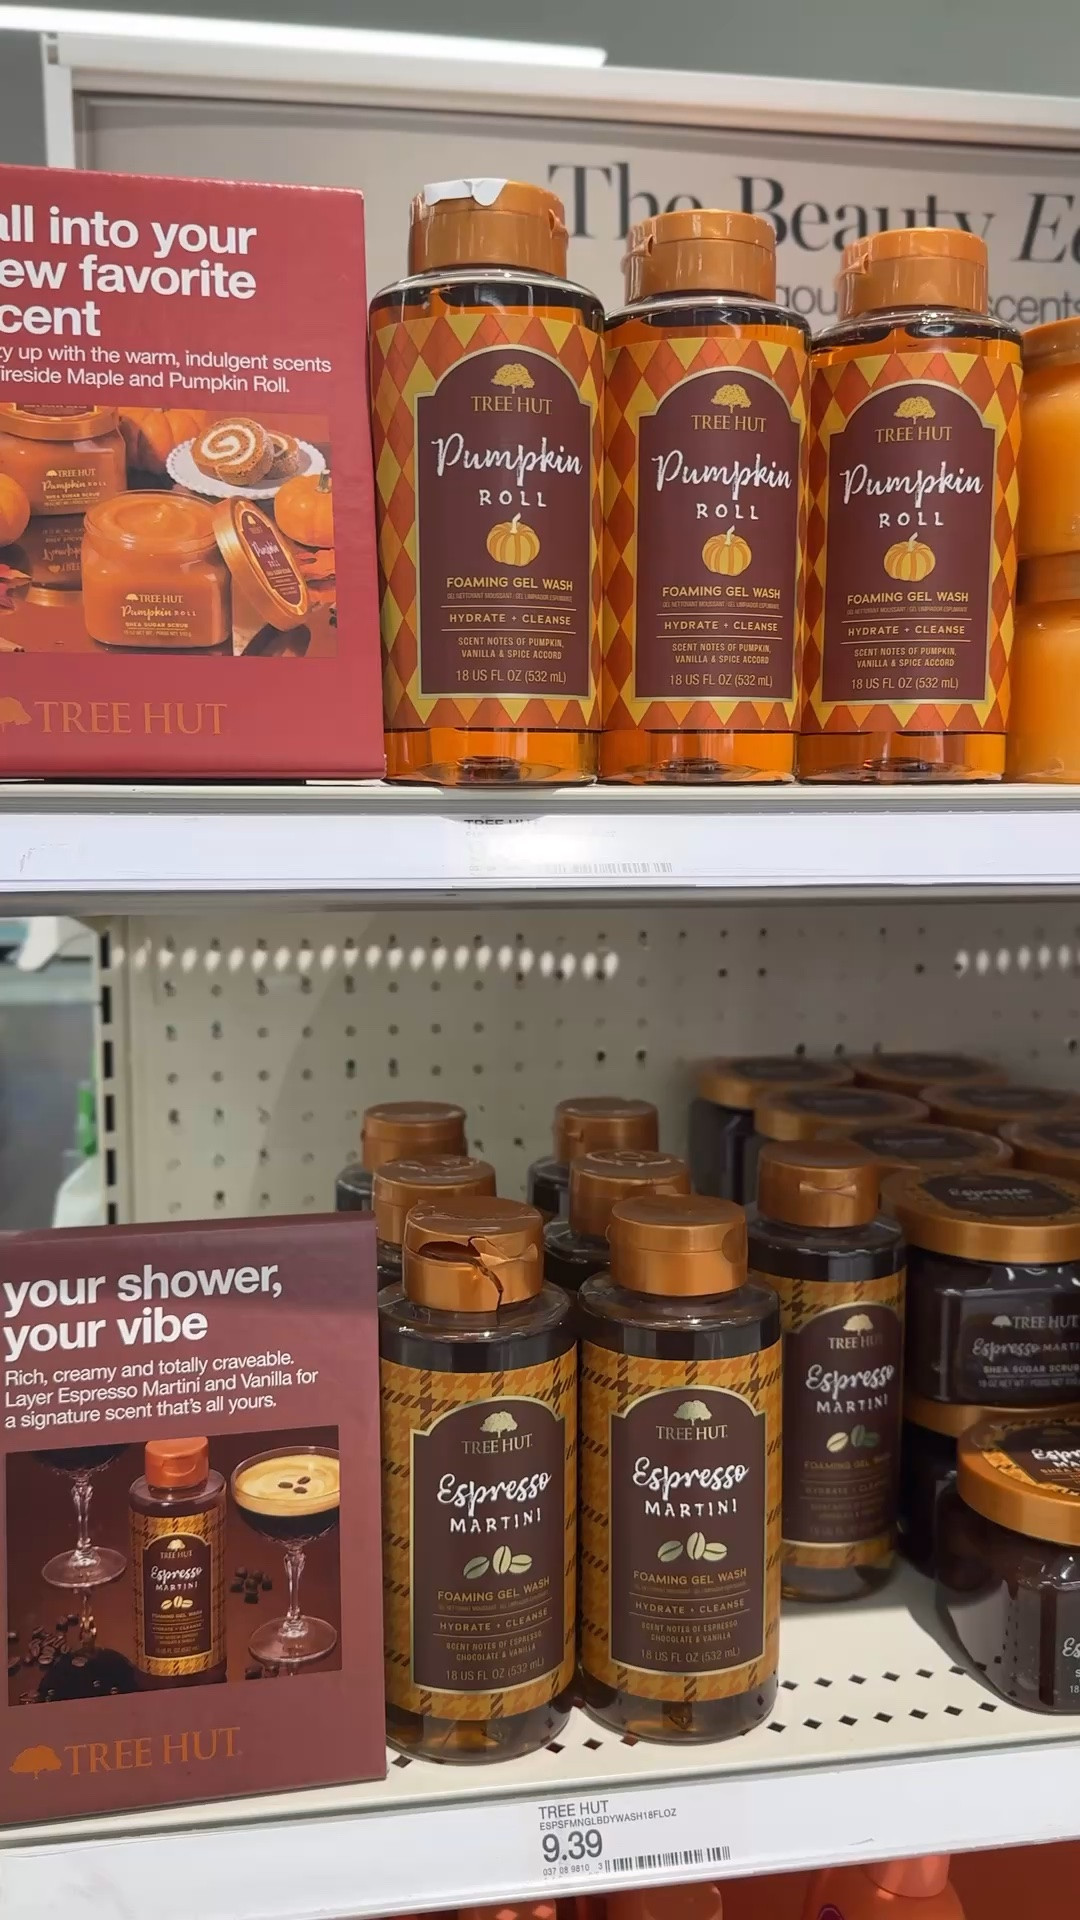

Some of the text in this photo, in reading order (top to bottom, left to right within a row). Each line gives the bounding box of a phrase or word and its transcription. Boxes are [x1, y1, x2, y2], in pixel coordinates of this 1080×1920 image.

[50, 205, 138, 248] into
[151, 221, 257, 259] your
[79, 254, 257, 299] favorite
[18, 344, 332, 374] up with the warm, indulgent scents
[67, 368, 124, 389] Maple
[129, 370, 164, 387] and
[169, 372, 248, 393] Pumpkin
[253, 376, 290, 393] Roll.
[471, 396, 553, 415] TREE HUT
[691, 414, 767, 433] TREE HUT
[875, 426, 952, 443] TREE HUT
[432, 432, 583, 487] Pumpkin
[651, 450, 792, 500] Pumpkin
[839, 461, 984, 508] Pumpkin
[479, 489, 547, 508] ROLL
[696, 503, 759, 520] ROLL
[879, 512, 944, 528] ROLL
[446, 577, 573, 591] FOAMING GEL WASH
[662, 586, 781, 599] FOAMING GEL WASH
[847, 591, 969, 605] FOAMING GEL WASH
[121, 604, 171, 620] Pumpkin
[449, 613, 571, 625] HYDRATE CLEANSE
[664, 621, 778, 632] HYDRATE CLEANSE
[848, 625, 965, 636] HYDRATE CLEANSE
[458, 637, 484, 646] SCENT
[487, 637, 513, 646] NOTES
[516, 637, 526, 646] OF
[672, 643, 697, 652] SCENT
[700, 643, 725, 652] NOTES
[727, 643, 737, 652] OF
[461, 649, 562, 660] VANILLA SPICE ACCORD
[675, 655, 769, 665] VANILLA SPICE ACCORD
[854, 648, 878, 657] SCENT
[880, 647, 905, 656] NOTES
[908, 647, 918, 656] OF
[857, 658, 955, 668] VANILLA SPICE ACCORD
[456, 670, 566, 684] 18 US FL OZ (532 mL)
[670, 674, 773, 688] 18 US FL OZ (532 mL)
[852, 678, 959, 690] 18 US FL OZ (532 mL)
[34, 701, 227, 736] TREE HUT
[3, 1264, 283, 1318] your shower,
[1012, 1314, 1080, 1329] TREE HUT
[3, 1306, 208, 1362] your vibe
[828, 1336, 858, 1350] TREE
[972, 1337, 1041, 1362] Espresso
[6, 1351, 295, 1387] Rich, creamy and totally craveable.
[6, 1368, 319, 1410] Layer Espresso Martini and Vanilla for
[805, 1363, 895, 1400] Espresso
[5, 1395, 277, 1431] a signature scent that's all yours.
[816, 1394, 888, 1414] MARTINI
[656, 1424, 728, 1440] TREE HUT
[461, 1433, 532, 1455] TREE HUT
[632, 1456, 750, 1501] Espresso
[436, 1471, 552, 1517] Espresso
[644, 1498, 738, 1518] MARTINI
[450, 1507, 542, 1533] MARTINI
[151, 1565, 203, 1584] Espresso
[633, 1567, 747, 1585] FOAMING GEL WASH
[155, 1581, 198, 1591] MARTINI
[437, 1590, 494, 1602] FOAMING
[497, 1588, 520, 1599] GEL
[523, 1576, 550, 1594] WASH
[635, 1599, 744, 1614] HYDRATE CLEANSE
[440, 1607, 548, 1632] HYDRATE CLEANSE
[64, 1727, 241, 1776] TREE HUT
[538, 1800, 609, 1819] TREE HUT
[540, 1808, 677, 1830] ESPSFMNGLBDYWASH18FLOZ
[542, 1829, 603, 1862] 9.39
[543, 1867, 557, 1876] 037
[559, 1866, 569, 1874] 08
[571, 1864, 590, 1872] 9810
